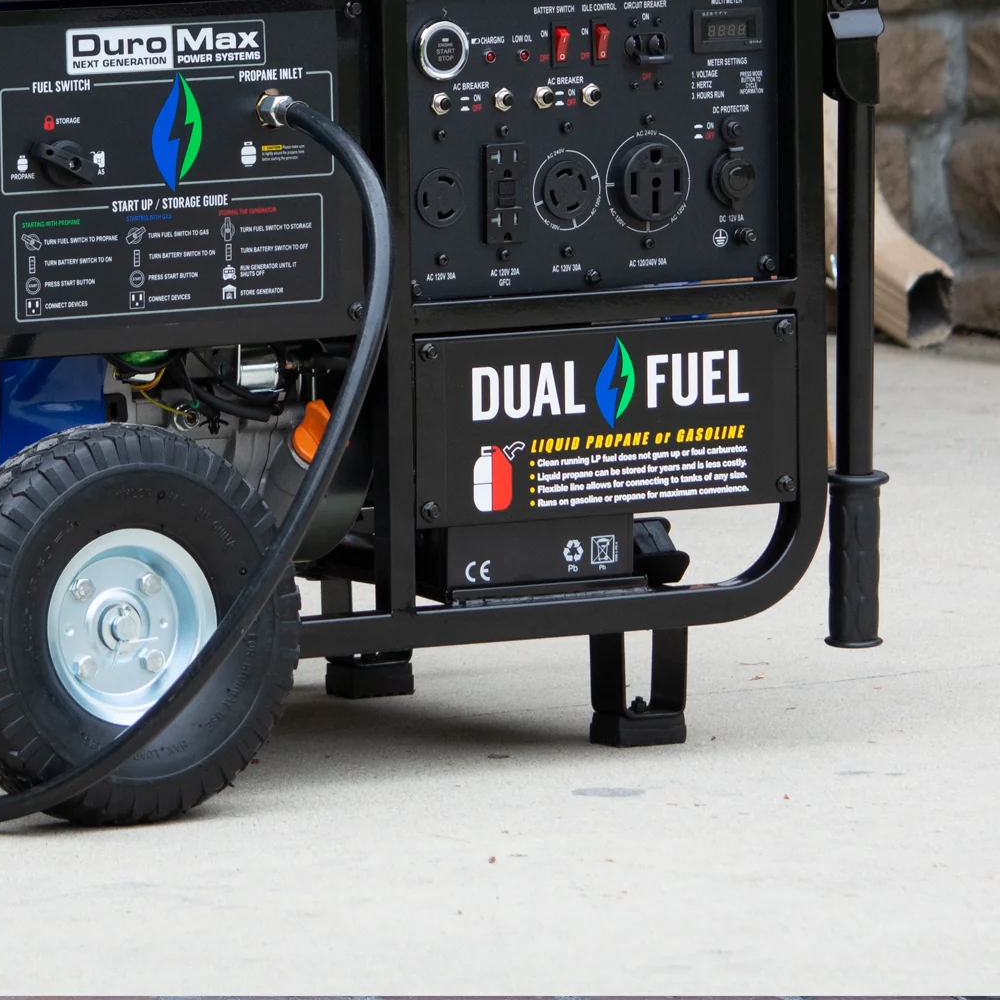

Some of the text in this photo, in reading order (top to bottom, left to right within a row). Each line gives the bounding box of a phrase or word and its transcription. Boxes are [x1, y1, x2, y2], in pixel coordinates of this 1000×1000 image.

[582, 3, 617, 12] IDLE CONTROL
[624, 0, 667, 9] CIRCUIT BREAKER
[534, 5, 575, 14] BATTERY SWITCH
[72, 27, 260, 57] Duro Max
[481, 36, 505, 44] CHARGING
[512, 35, 523, 43] LOW
[73, 51, 260, 69] NEXT GENERATION POWER SYSTEMS
[707, 57, 747, 66] METER SETTINGS
[239, 67, 303, 82] PROPANE INLET
[696, 70, 718, 78] VOLTAGE
[557, 76, 584, 84] BREAKER
[32, 79, 90, 93] FUEL SWITCH
[462, 81, 489, 90] BREAKER
[697, 91, 713, 99] HOURS
[472, 104, 482, 112] OFF
[713, 105, 749, 114] DC PROTECTOR
[56, 117, 80, 125] STORAGE
[112, 194, 228, 212] START UP / STORAGE GUIDE
[490, 269, 498, 277] AC
[499, 268, 510, 276] 120V
[256, 287, 283, 295] GENERATOR
[472, 349, 750, 421] DUAL FUEL
[531, 425, 745, 453] LIQUID PROPANE or GASOLINE
[537, 459, 559, 467] Clean
[561, 456, 590, 465] running
[591, 455, 601, 463] LP
[603, 454, 617, 462] fuel
[619, 453, 636, 461] does
[638, 451, 651, 460] not
[652, 451, 669, 460] gum
[671, 450, 680, 459] up
[691, 447, 705, 455] foul
[707, 445, 747, 455] carburetor.
[537, 472, 560, 482] Liquid
[562, 471, 593, 481] propane
[611, 468, 620, 476] be
[622, 466, 645, 475] stored
[647, 465, 658, 473] for
[659, 464, 680, 474] years
[682, 461, 696, 470] and
[698, 460, 704, 469] is
[706, 460, 721, 468] less
[722, 458, 747, 468] costly.
[537, 484, 568, 493] Flexible
[570, 483, 584, 491] line
[586, 481, 611, 490] allows
[613, 480, 624, 488] for
[626, 477, 669, 486] connecting
[681, 474, 702, 482] tanks
[714, 473, 728, 482] any
[730, 471, 747, 479] size.
[538, 499, 557, 507] Runs
[570, 495, 602, 506] gasoline
[614, 492, 645, 503] propane
[647, 490, 658, 498] for
[659, 488, 697, 498] maximum
[699, 485, 749, 494] convenience.
[466, 560, 490, 582] CE
[568, 564, 578, 572] Pb
